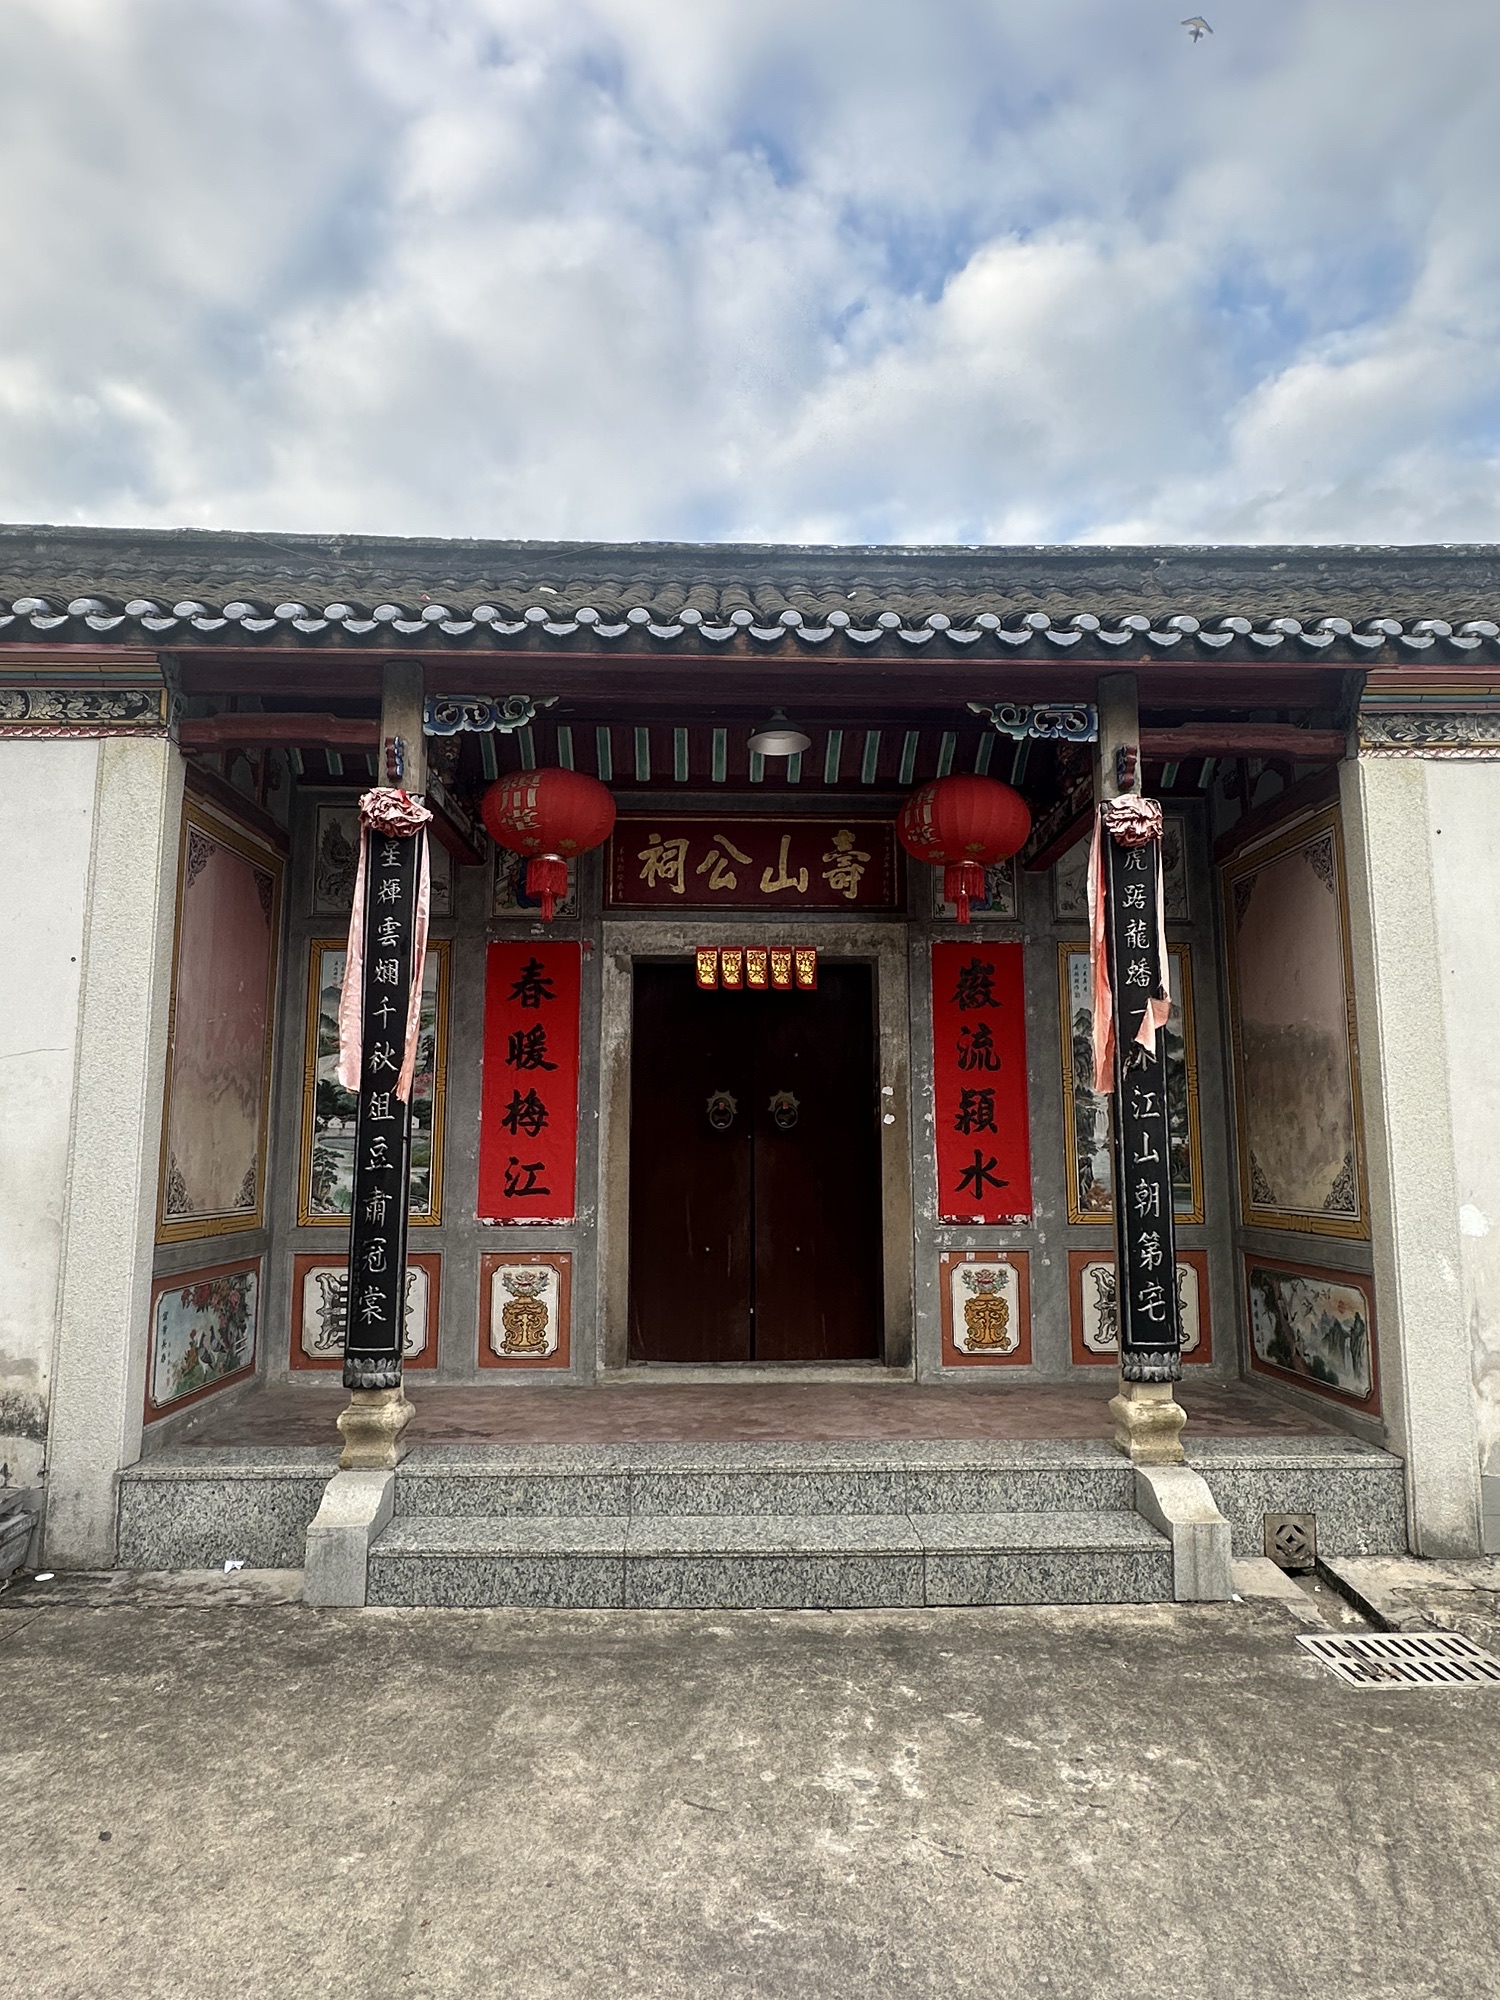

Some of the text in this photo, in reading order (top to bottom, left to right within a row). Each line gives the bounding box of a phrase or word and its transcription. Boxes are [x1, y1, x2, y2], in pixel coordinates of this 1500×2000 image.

[638, 829, 871, 899] 壽山公祠
[501, 957, 558, 1198] 春暖梅江
